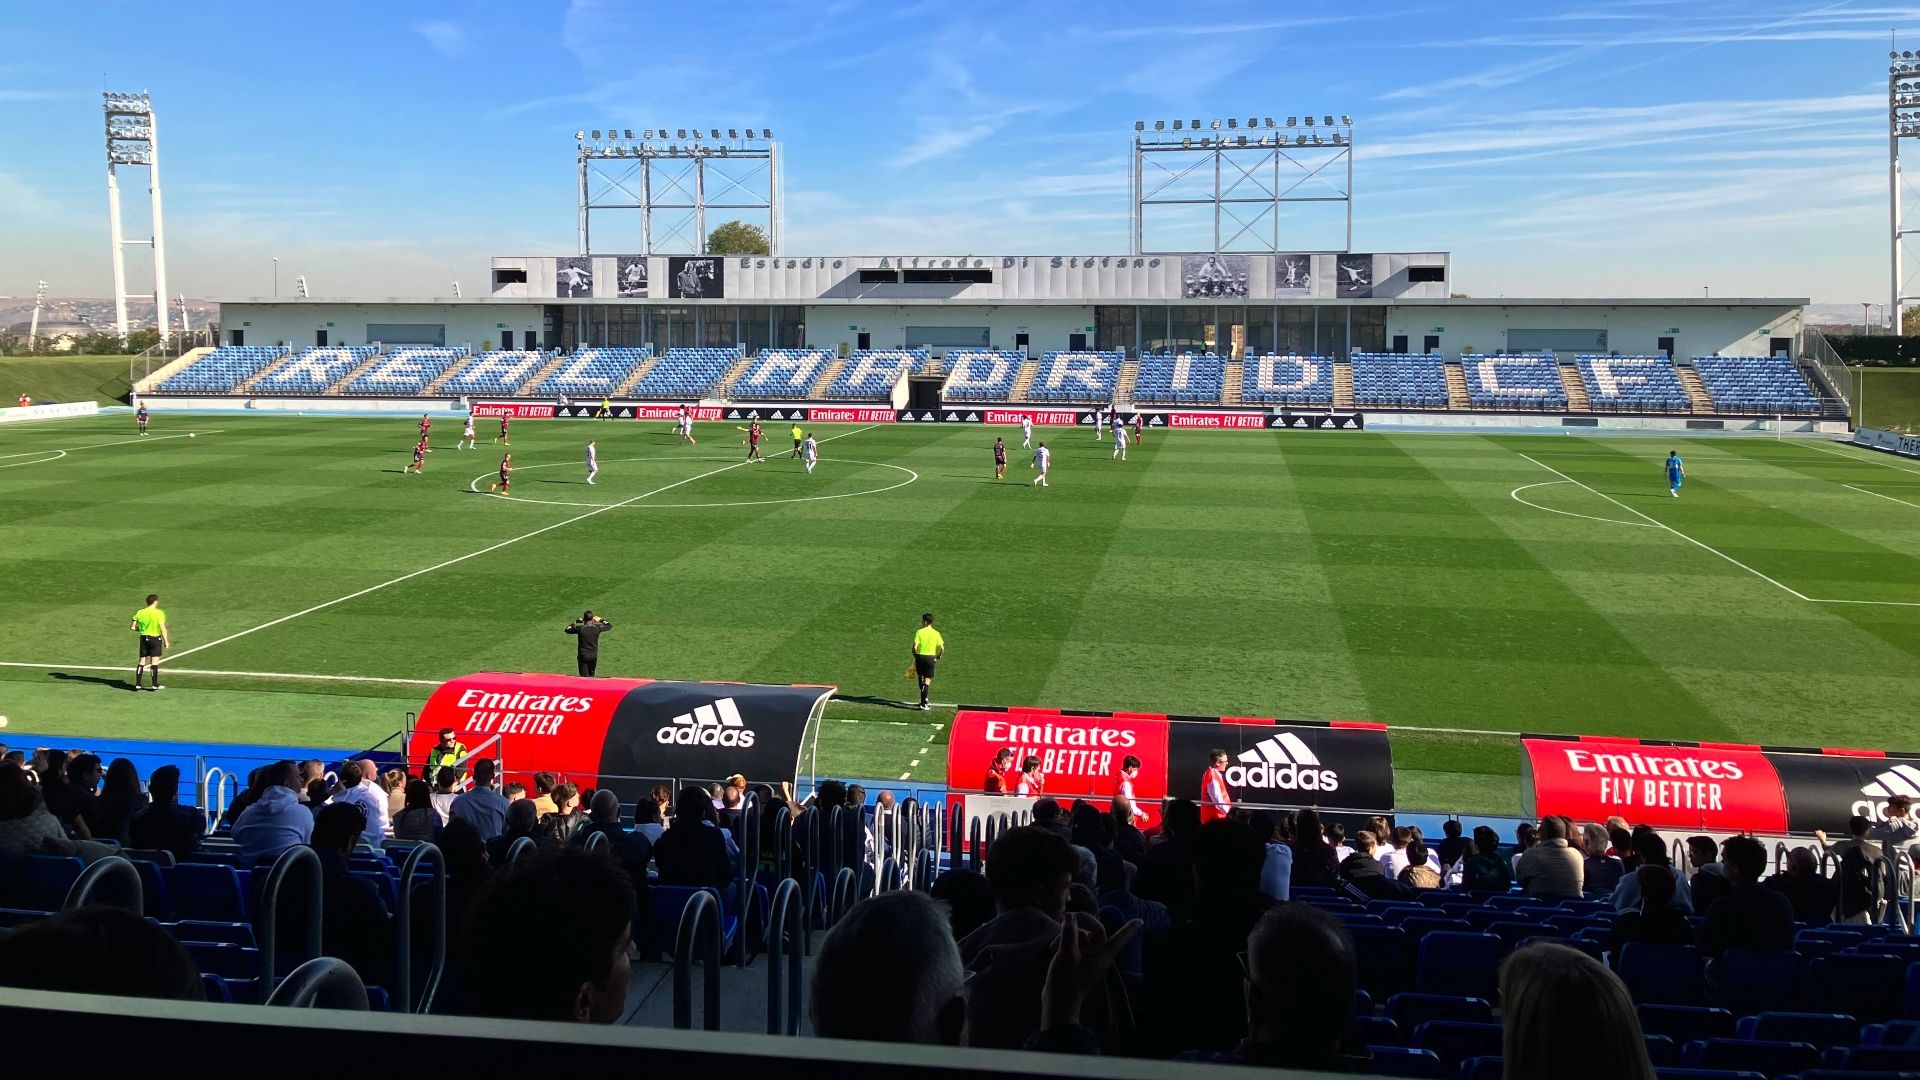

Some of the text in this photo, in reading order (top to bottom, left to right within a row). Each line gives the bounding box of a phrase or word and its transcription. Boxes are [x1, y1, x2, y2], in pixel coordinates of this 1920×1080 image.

[740, 257, 843, 269] Estadio
[878, 255, 984, 269] Alfredo
[1003, 256, 1028, 269] Di
[273, 350, 1655, 398] REAL MADRID CF
[517, 406, 529, 416] FLY
[529, 406, 553, 417] BETTER
[810, 409, 895, 421] Emirates FLY BETTER
[1036, 412, 1048, 424] FLY
[1048, 413, 1074, 424] BETTER
[1171, 414, 1264, 427] Emirates FLY BETTER
[457, 689, 593, 713] Emirates
[465, 711, 564, 736] FLY BETTER
[656, 723, 755, 748] adidas
[985, 720, 1136, 748] Emirates
[1042, 748, 1112, 776] BETTER
[1564, 749, 1743, 780] Emirates
[1226, 761, 1339, 792] adidas
[1601, 777, 1723, 811] FLY BETTER
